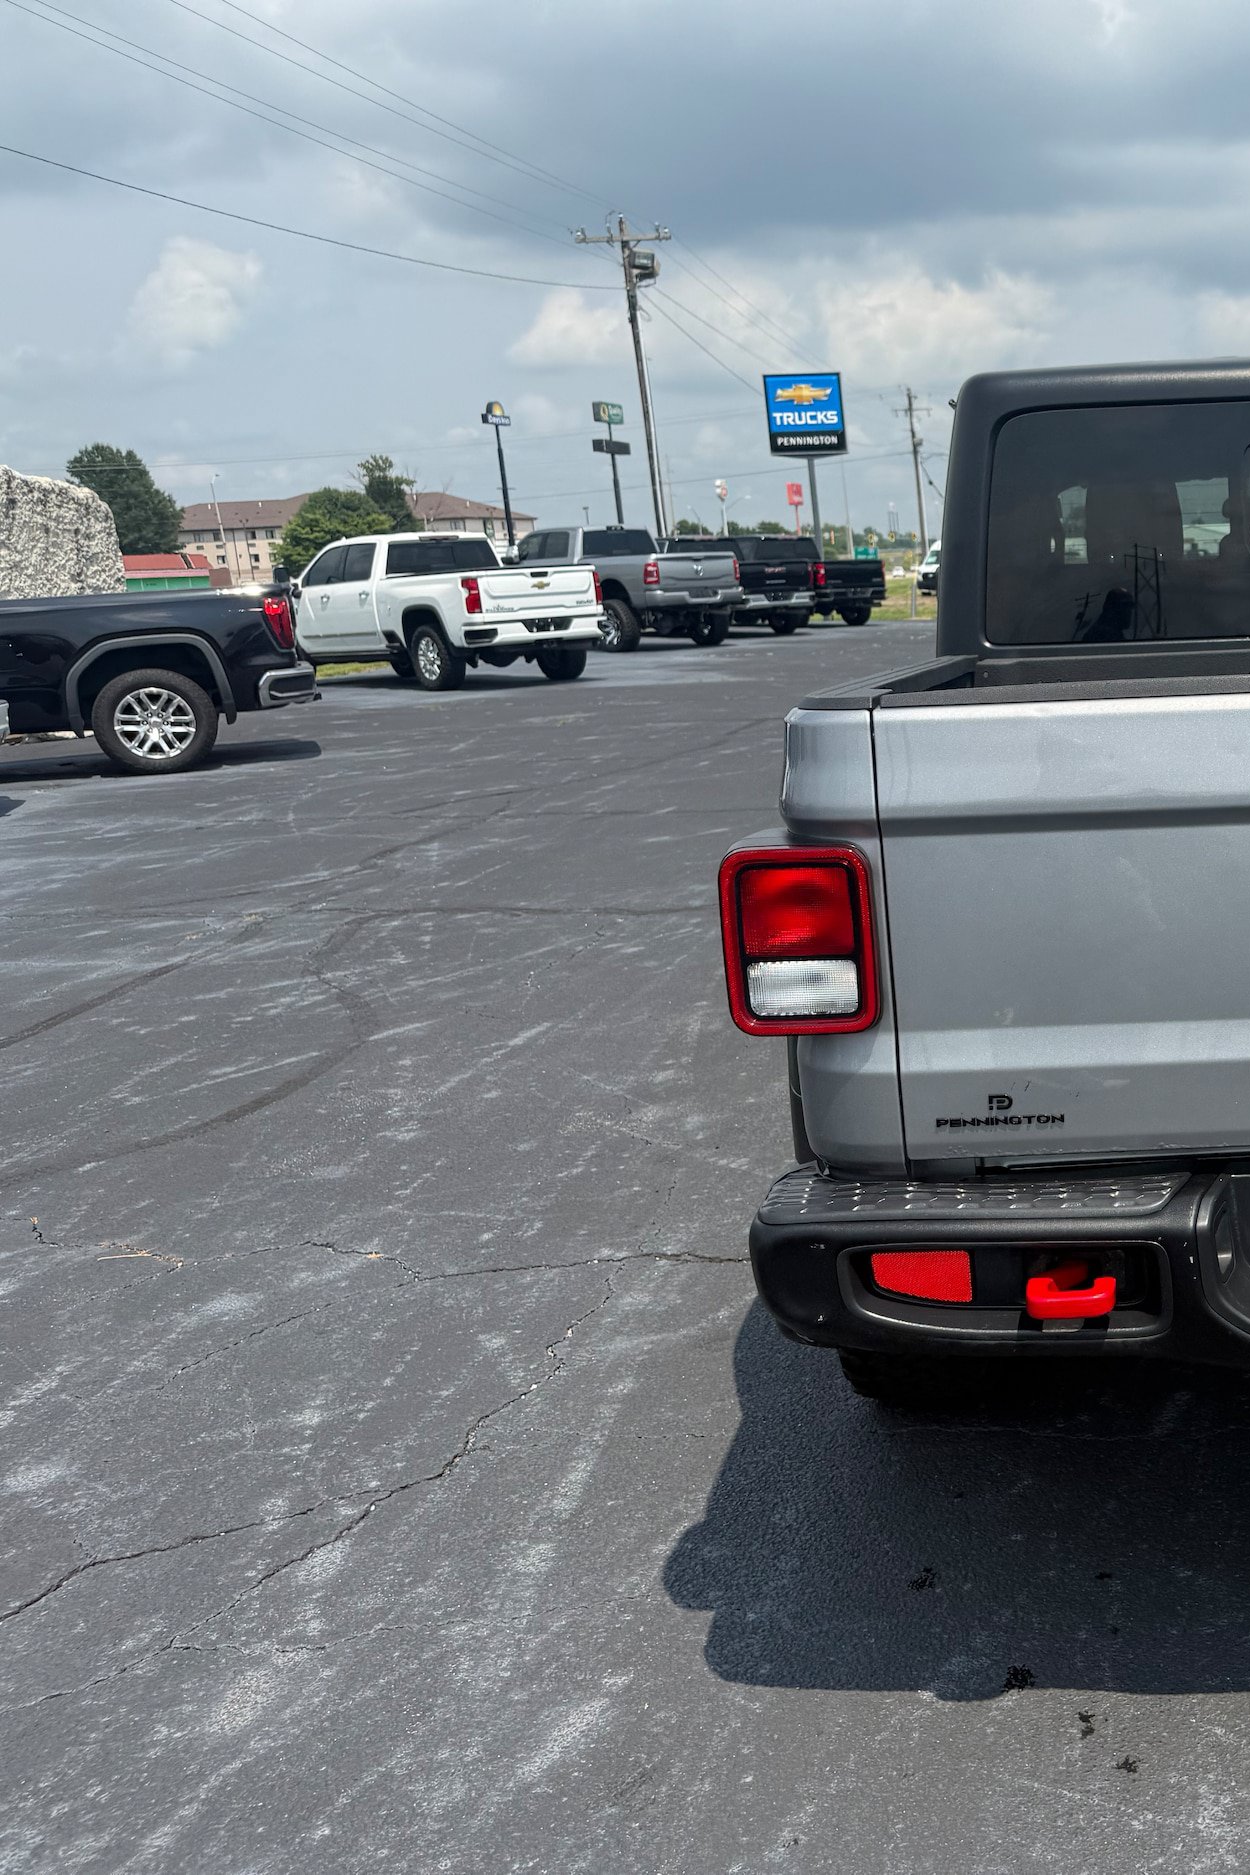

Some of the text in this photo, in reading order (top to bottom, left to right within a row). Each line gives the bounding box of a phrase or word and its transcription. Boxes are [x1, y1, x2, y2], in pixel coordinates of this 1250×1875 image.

[772, 410, 838, 426] TRUCKS
[776, 435, 838, 447] PENNINGTON
[935, 1113, 1066, 1129] PENNINGTON
